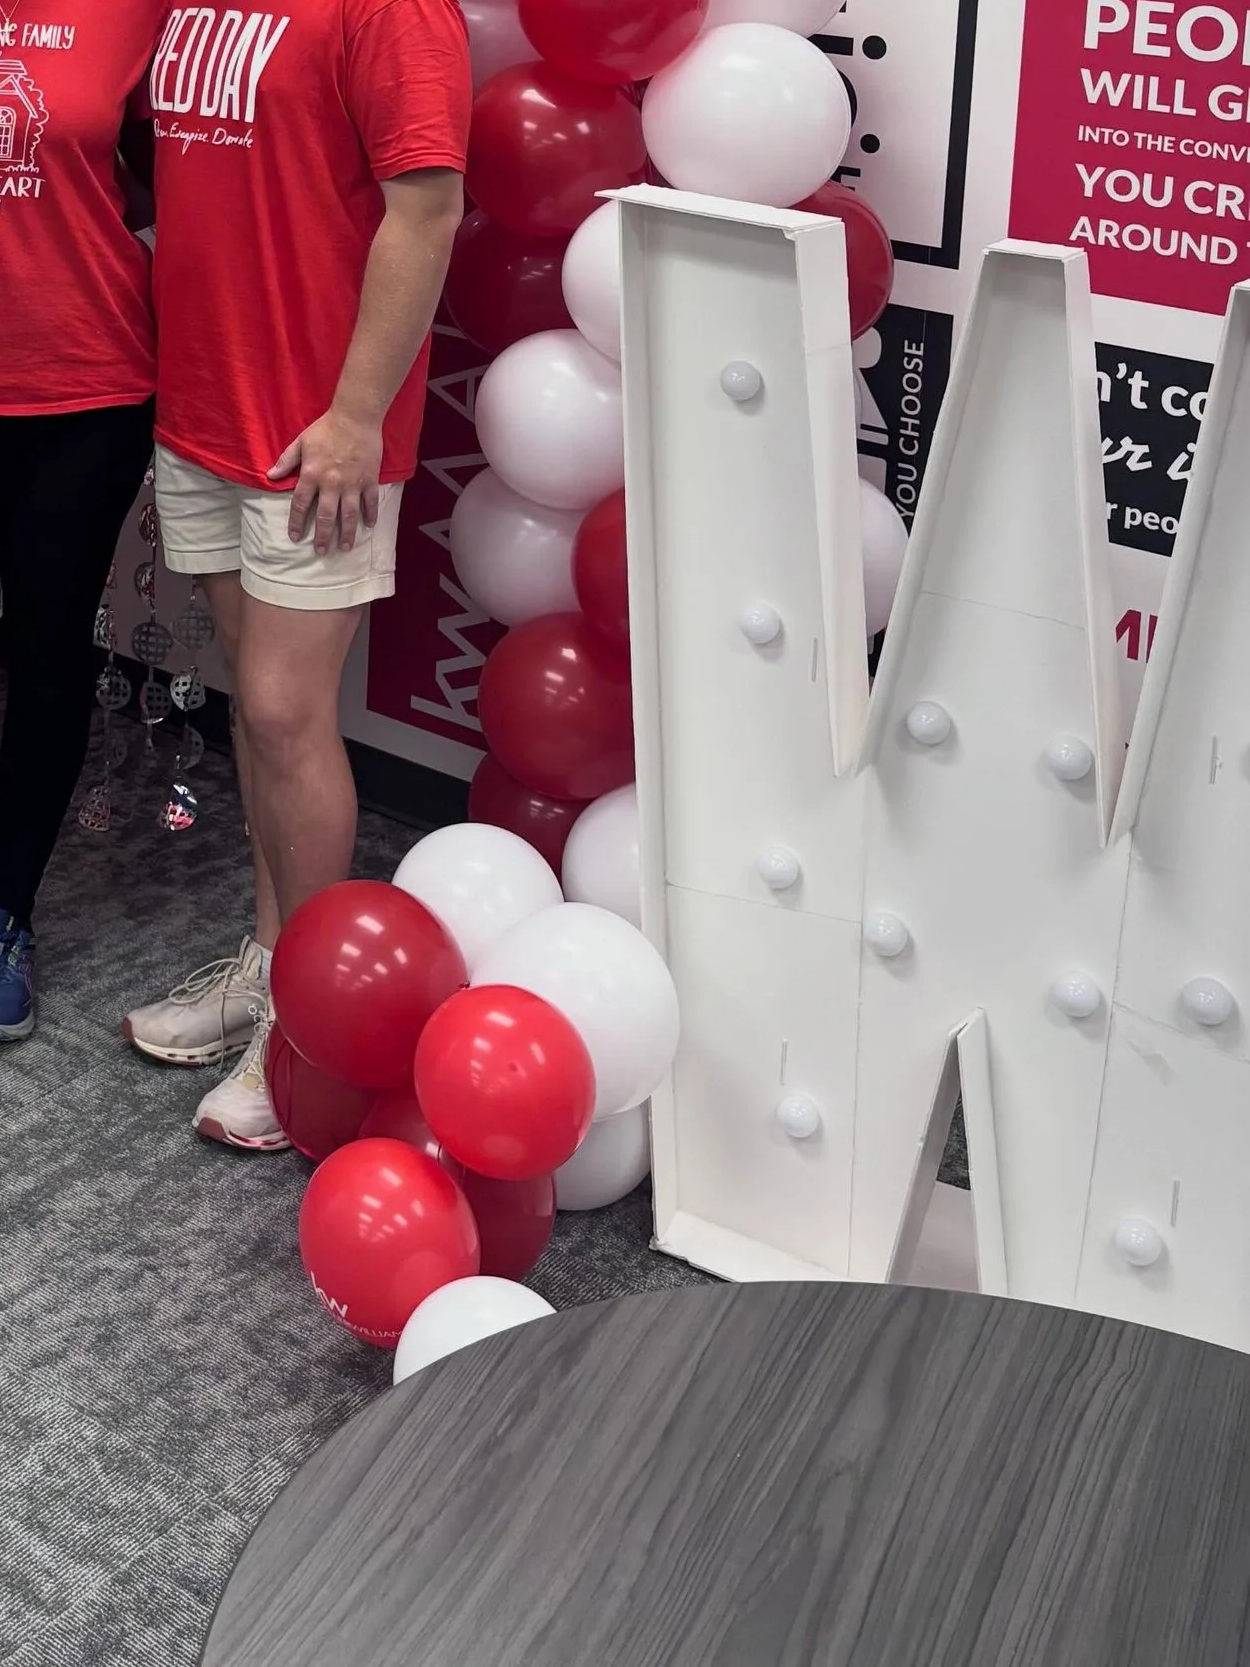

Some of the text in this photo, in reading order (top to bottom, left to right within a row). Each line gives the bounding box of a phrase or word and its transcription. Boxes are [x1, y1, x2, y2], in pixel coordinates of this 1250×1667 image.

[21, 23, 76, 50] FAMILY
[150, 7, 291, 123] RED DAY
[1080, 67, 1197, 117] WILL
[1078, 124, 1130, 147] INTO
[1133, 131, 1176, 153] THE
[1075, 163, 1175, 208] YOU
[1069, 215, 1238, 265] AROUND
[896, 340, 925, 518] YOU CHOOSE
